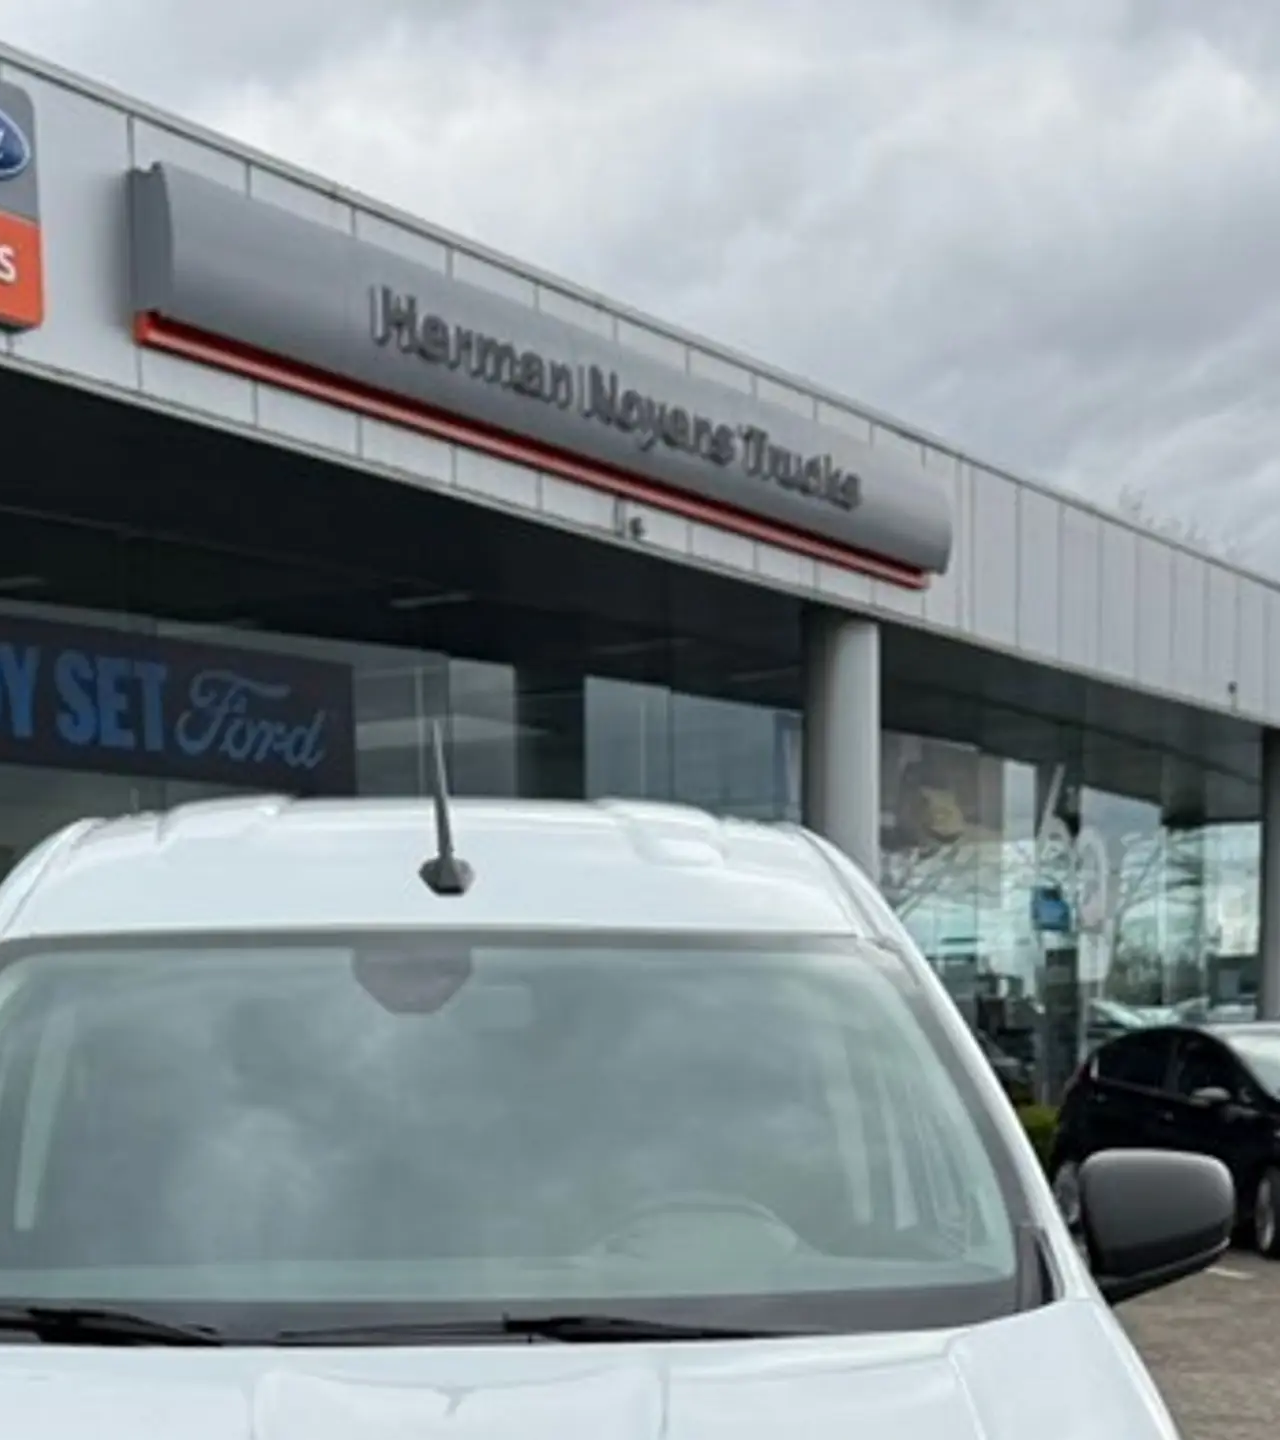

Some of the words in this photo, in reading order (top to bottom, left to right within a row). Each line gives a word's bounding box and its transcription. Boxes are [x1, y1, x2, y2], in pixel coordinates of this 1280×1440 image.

[368, 284, 572, 411] Herman
[735, 422, 863, 512] Trucks
[53, 649, 168, 753] SET
[174, 668, 327, 770] Ford
